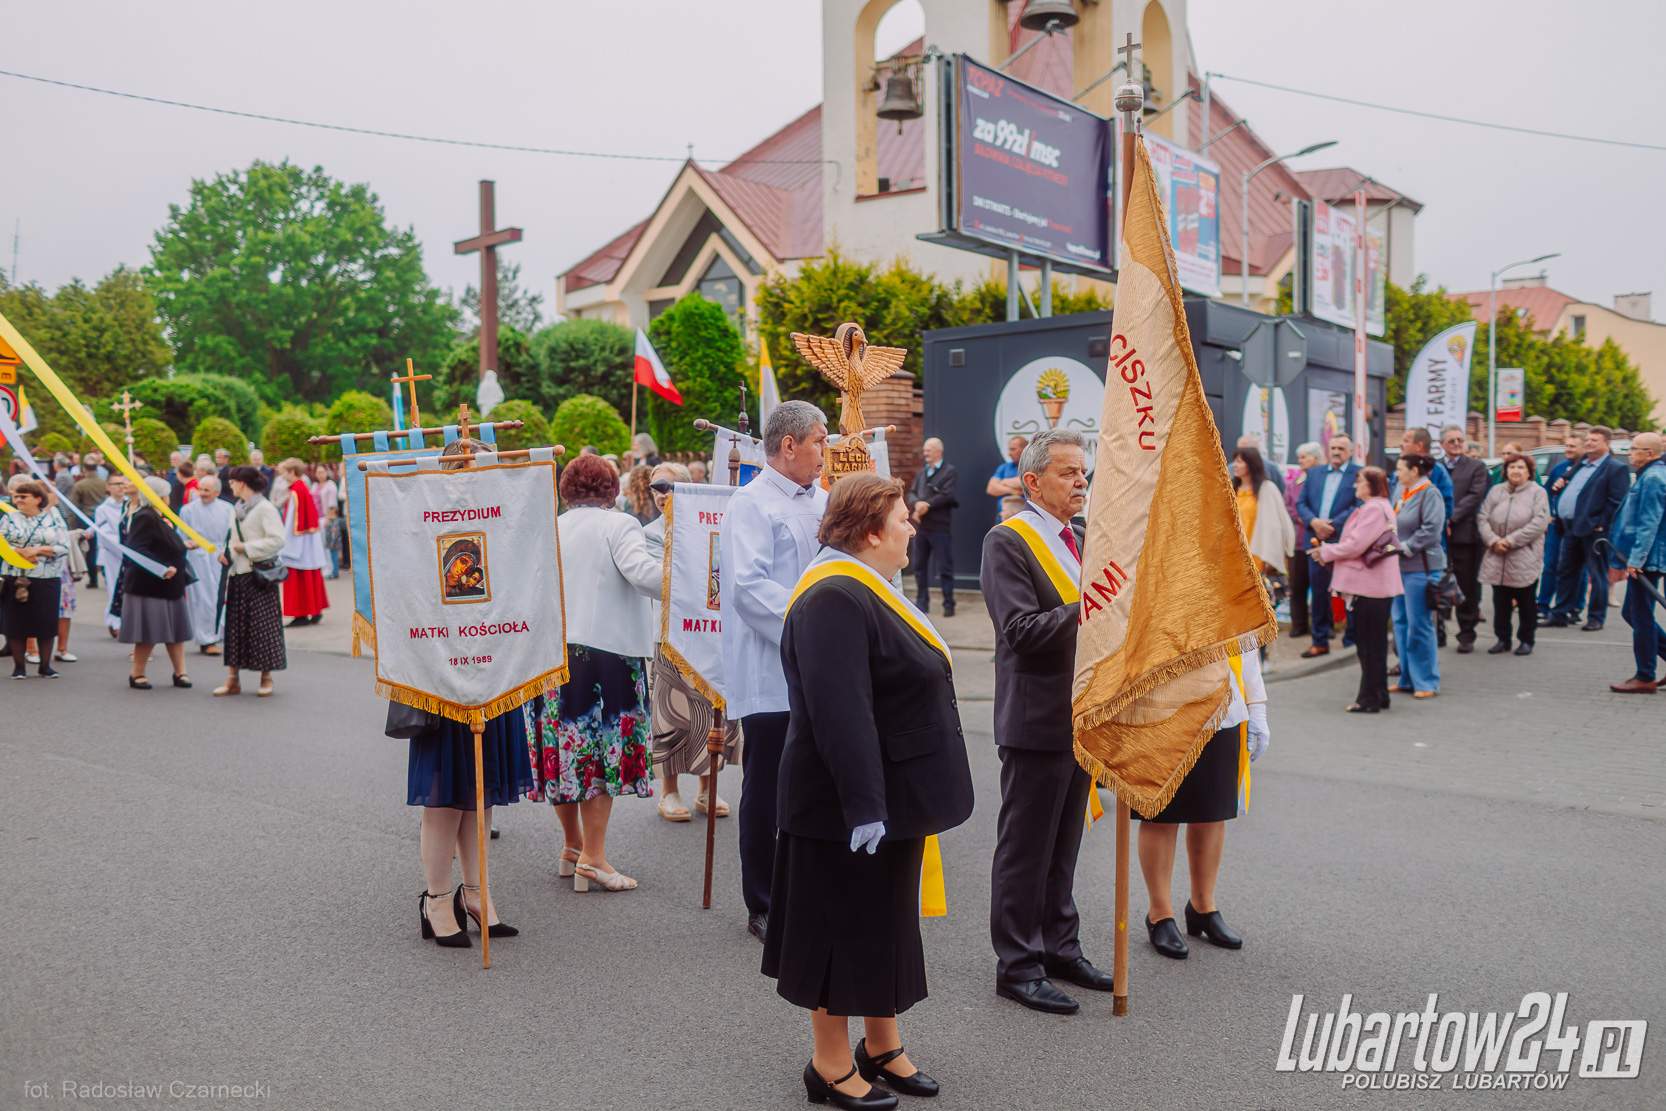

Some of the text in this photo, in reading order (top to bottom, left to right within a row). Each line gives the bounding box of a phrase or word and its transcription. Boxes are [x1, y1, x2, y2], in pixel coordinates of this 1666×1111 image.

[973, 118, 996, 143] za
[1029, 140, 1061, 168] msc
[1109, 334, 1156, 451] CISZKU
[1426, 358, 1448, 416] FARMY
[423, 505, 501, 523] PREZYDIUM
[409, 620, 530, 639] MATKI KOŚCIOŁA
[682, 618, 722, 633] MATKI
[448, 657, 459, 666] 18
[460, 656, 469, 665] IX
